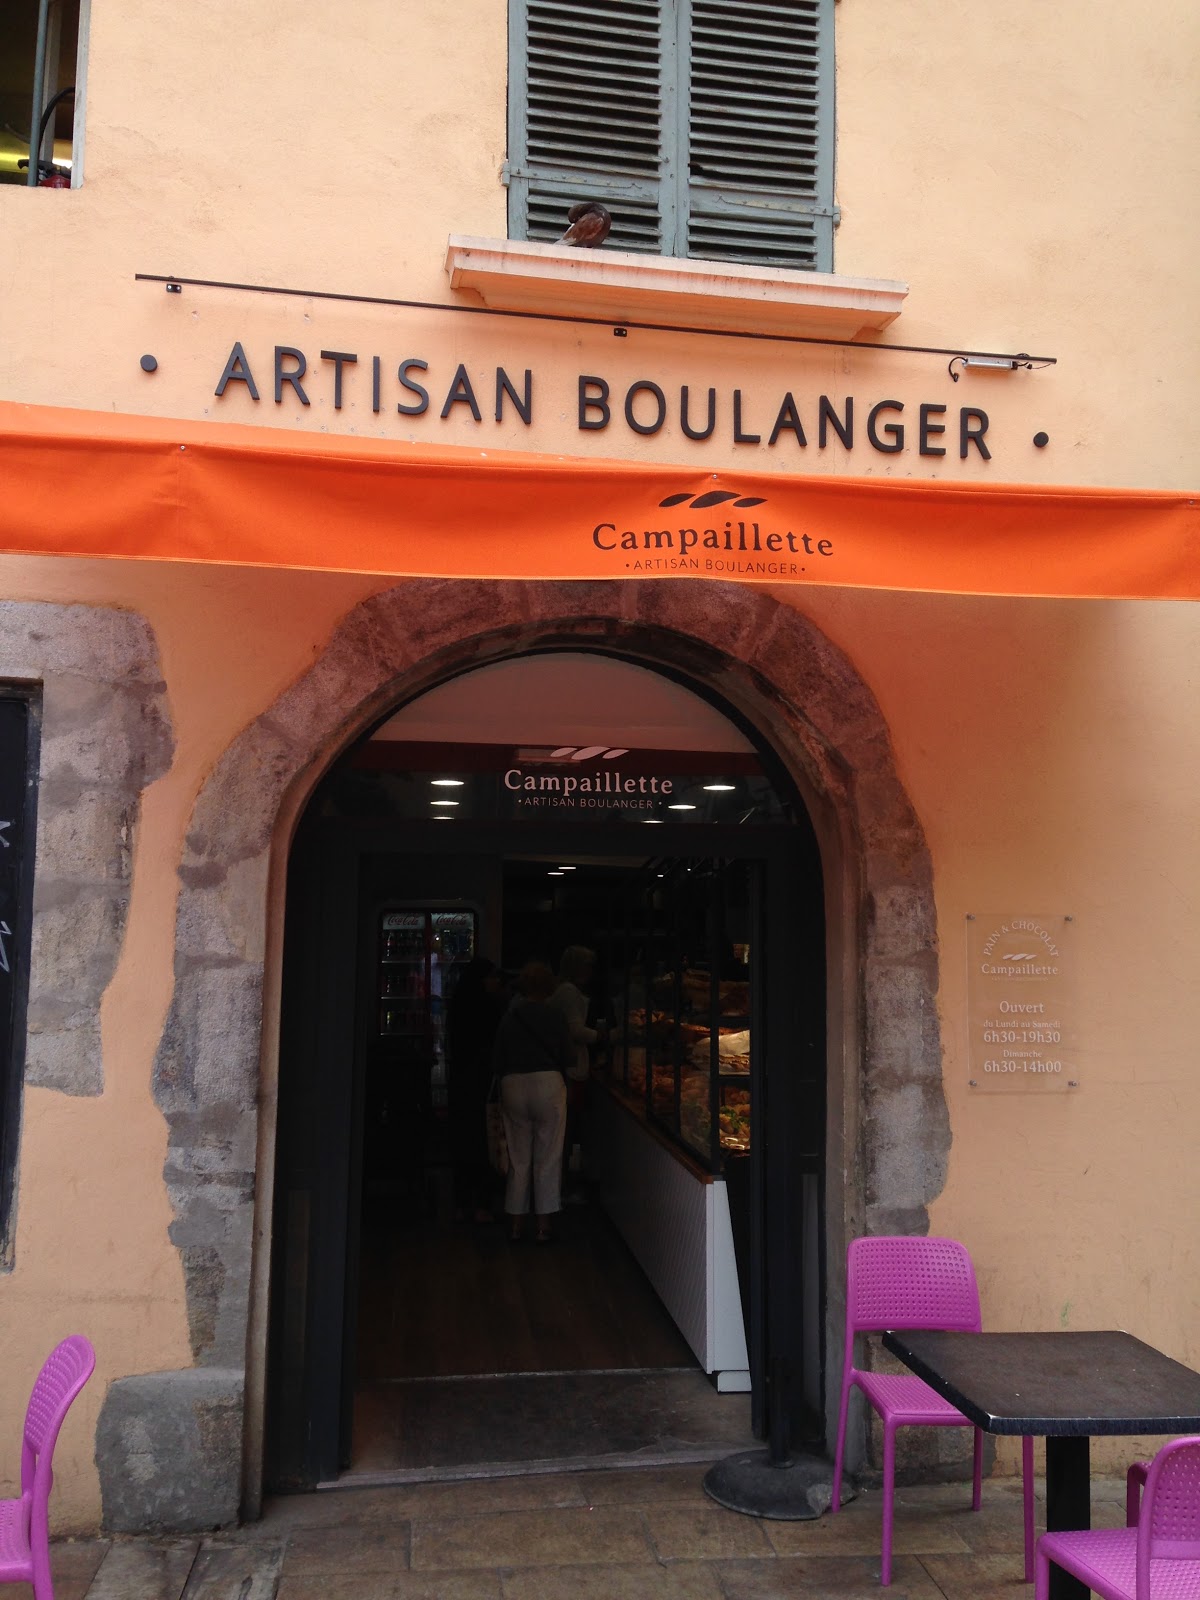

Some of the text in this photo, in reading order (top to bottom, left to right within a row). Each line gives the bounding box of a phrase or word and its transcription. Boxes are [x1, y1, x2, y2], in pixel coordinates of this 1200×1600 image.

[214, 341, 993, 461] ARTISAN BOULANGER
[592, 521, 834, 557] Campaillette
[633, 558, 799, 575] ARTISAN BOULANGER
[503, 768, 673, 797] Campaillette
[524, 797, 654, 810] ARTISAN BOULANGER
[983, 920, 1060, 957] PAIN & CHOCOLAT
[981, 963, 1059, 977] Campaillette
[999, 1000, 1045, 1014] Ouvert
[983, 1020, 994, 1028] du
[995, 1020, 1019, 1028] Lundi
[1032, 1020, 1061, 1029] Samedi
[983, 1031, 1061, 1043] 6h30-19h30
[1003, 1049, 1042, 1058] Dimanche
[983, 1060, 1062, 1073] 6h30-14h00
